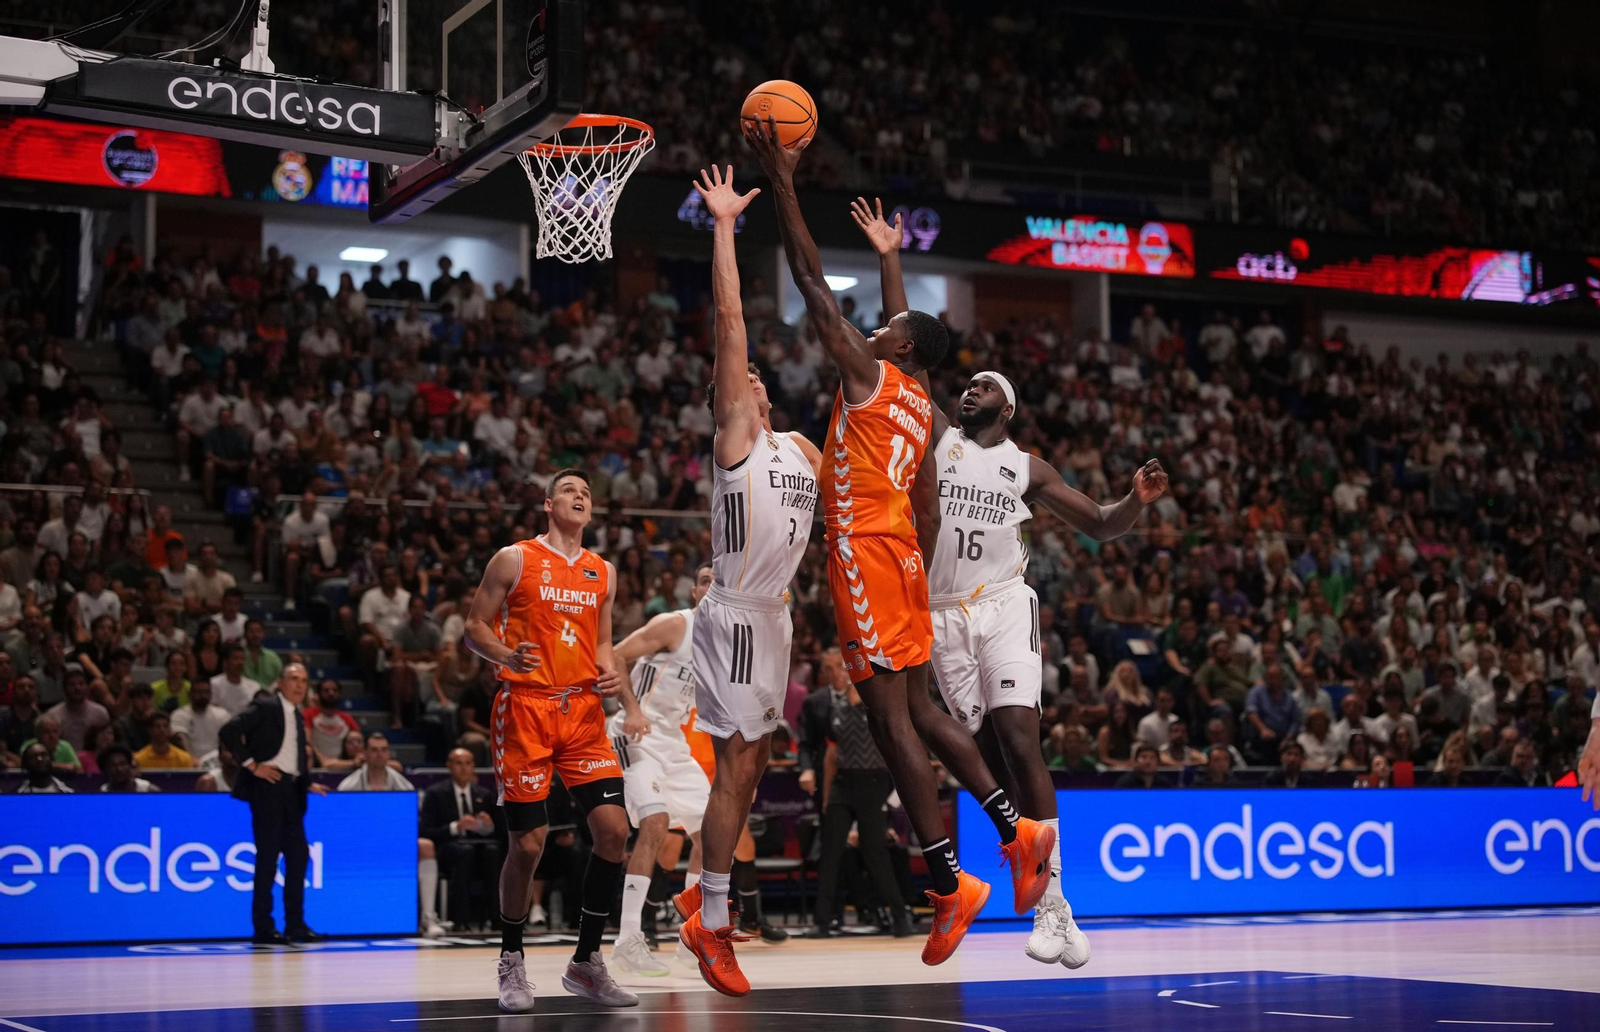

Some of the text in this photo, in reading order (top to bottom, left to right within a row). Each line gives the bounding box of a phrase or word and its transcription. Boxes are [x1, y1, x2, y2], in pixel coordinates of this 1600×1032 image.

[167, 76, 381, 136] endesa
[1026, 216, 1129, 246] VALENCIA
[1052, 243, 1129, 269] BASKET
[1237, 251, 1298, 280] acb
[938, 480, 1016, 513] Emirates
[946, 502, 1006, 525] FLY BETTER
[789, 518, 797, 546] 3
[955, 527, 985, 561] 16
[539, 586, 597, 608] VALENCIA
[553, 603, 584, 614] BASKET
[561, 620, 577, 647] 4
[586, 759, 617, 771] Midea
[1100, 804, 1394, 882] endesa
